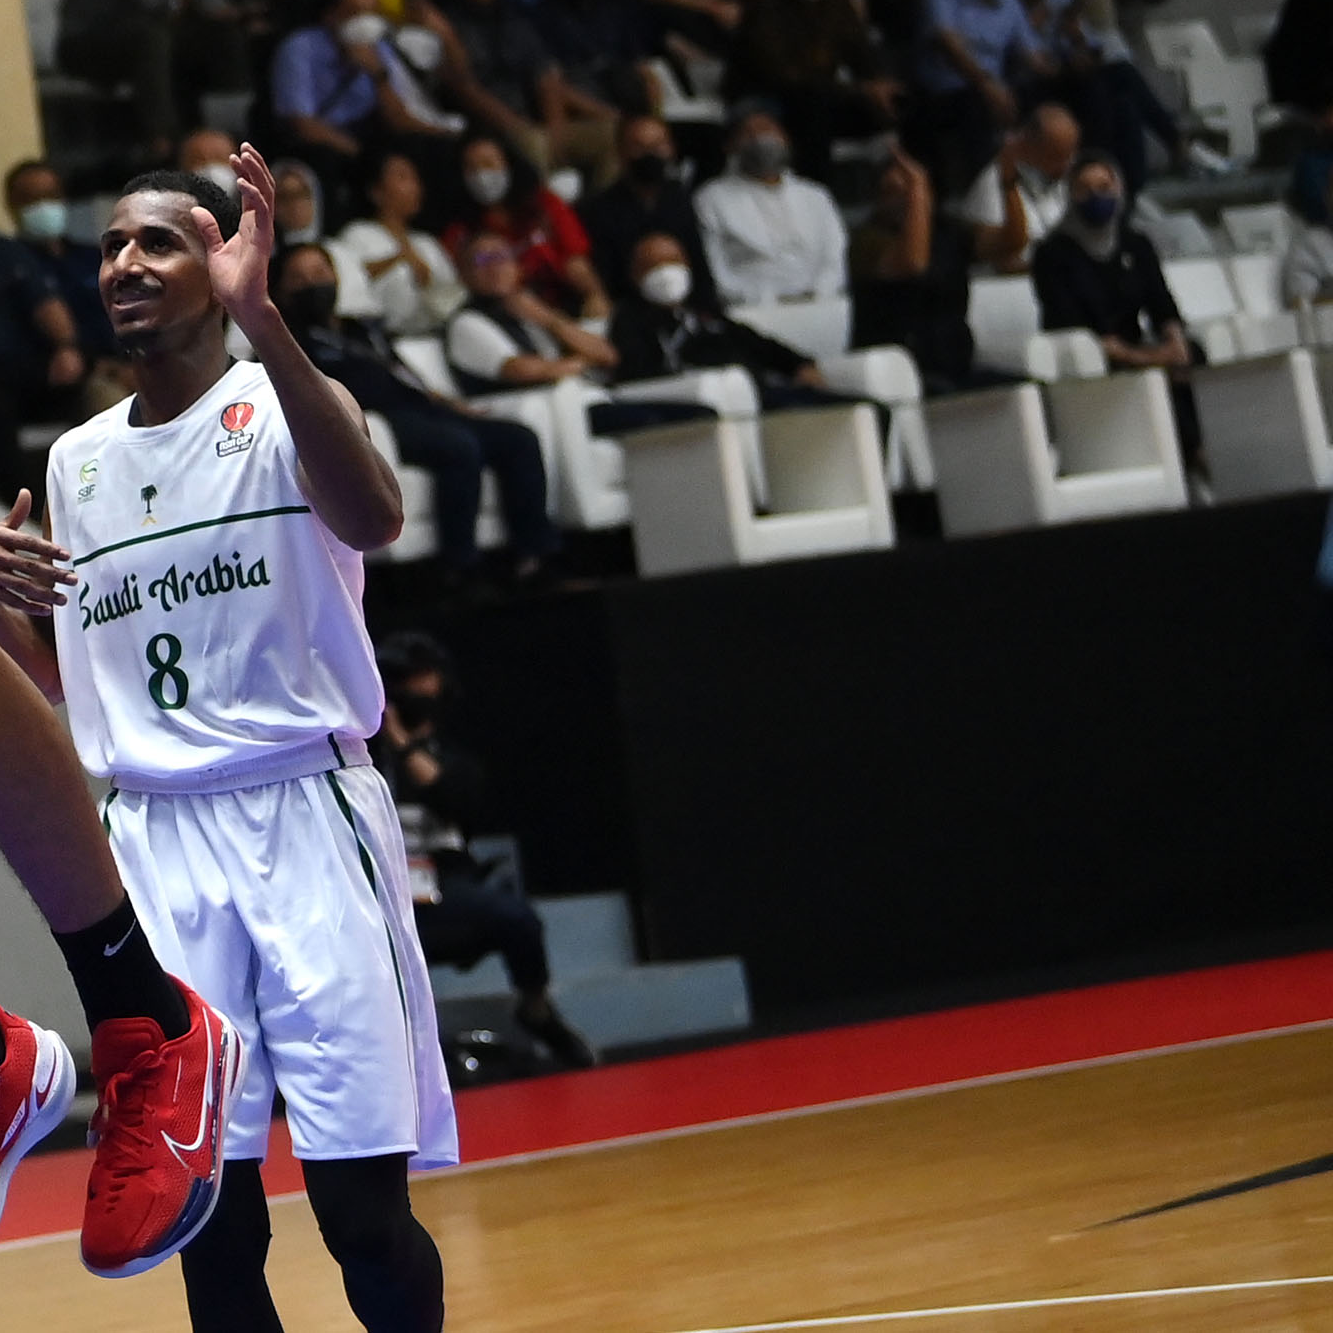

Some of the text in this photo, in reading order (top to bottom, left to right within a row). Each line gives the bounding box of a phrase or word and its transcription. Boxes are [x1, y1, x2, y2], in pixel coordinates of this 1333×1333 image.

[79, 551, 270, 631] Saudi Arabia
[146, 633, 189, 710] 8
